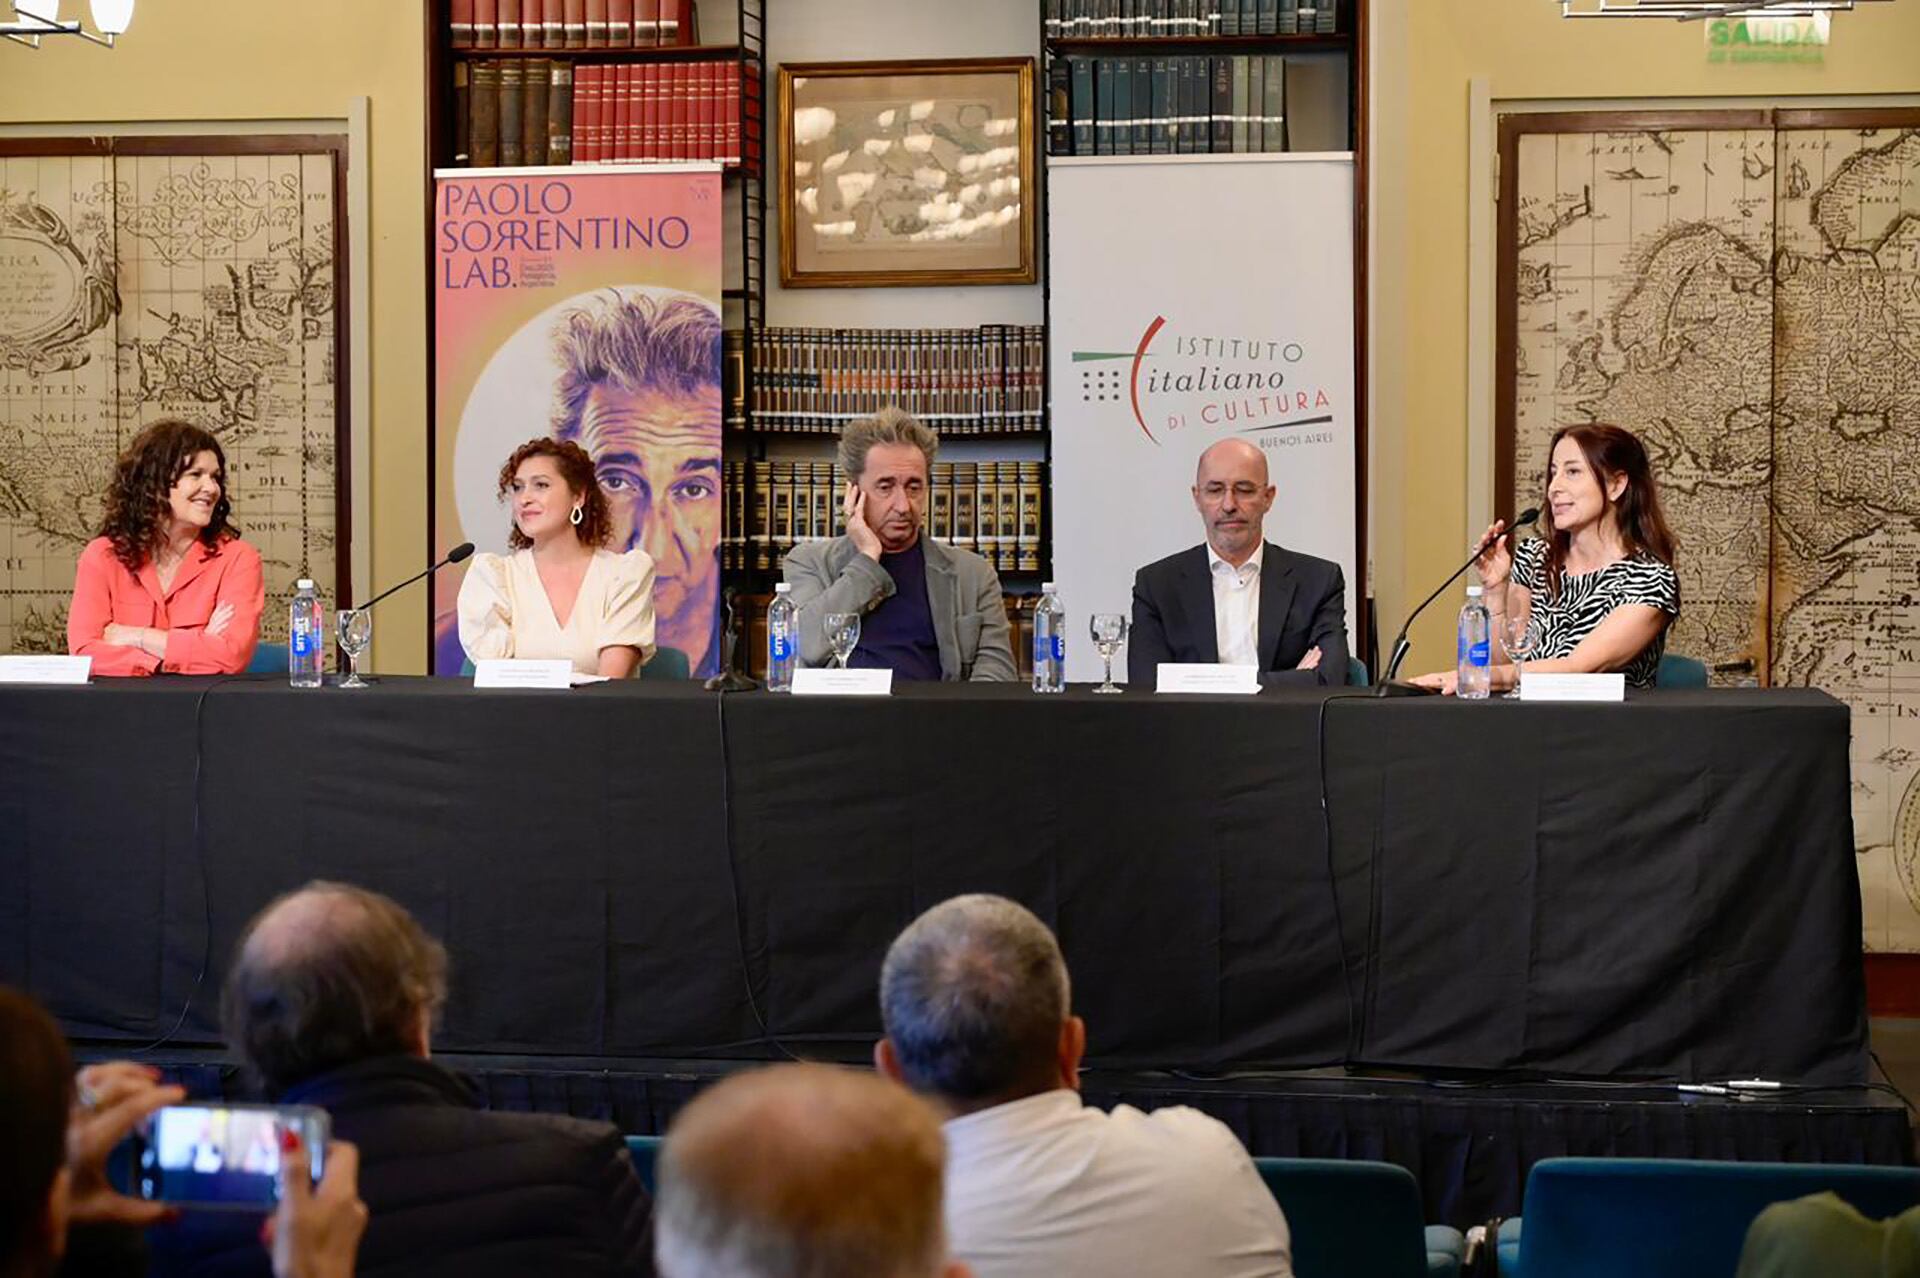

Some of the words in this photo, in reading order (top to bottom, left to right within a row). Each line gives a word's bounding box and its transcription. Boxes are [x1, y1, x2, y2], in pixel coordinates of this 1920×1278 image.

[1709, 21, 1825, 46] SALIDA
[445, 182, 572, 216] PAOLO
[442, 216, 690, 253] SORRENTINO
[445, 257, 517, 289] LAB.
[1177, 336, 1303, 363] ISTITUTO
[1149, 367, 1284, 393] italiano
[1167, 415, 1186, 430] DI
[1201, 390, 1330, 424] CULTURA
[1259, 435, 1302, 449] BUENOS
[1305, 431, 1333, 445] AIRES
